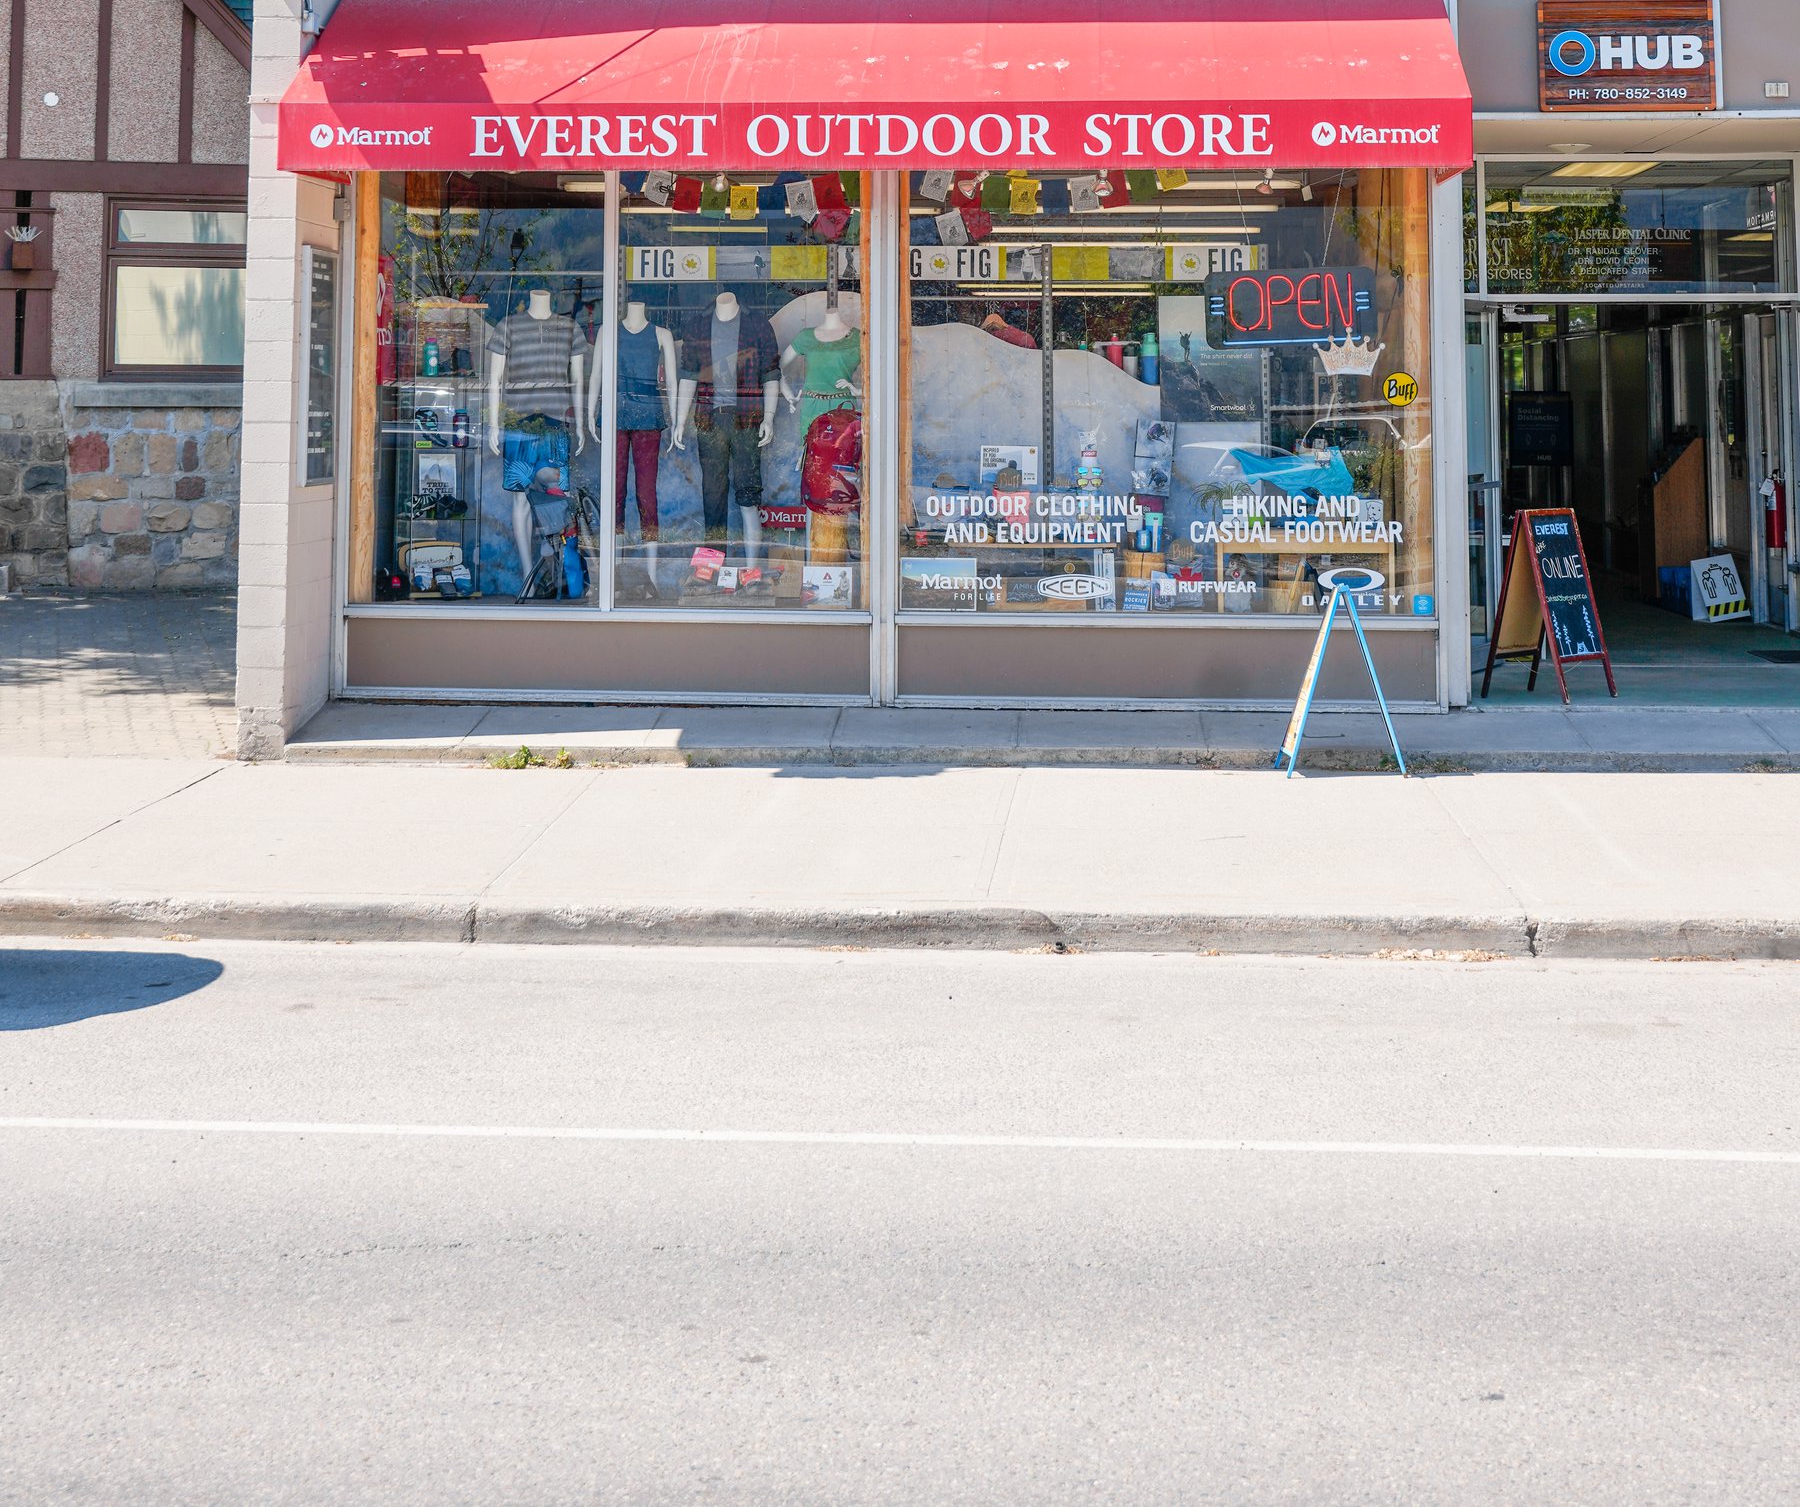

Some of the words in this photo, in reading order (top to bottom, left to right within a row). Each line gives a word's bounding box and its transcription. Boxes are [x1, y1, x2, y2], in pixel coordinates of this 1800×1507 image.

[1599, 35, 1705, 70] HUB
[1568, 89, 1590, 100] PH:
[1593, 87, 1688, 99] 780-852-3149
[336, 125, 433, 146] Marmot
[469, 113, 718, 157] EVEREST
[746, 113, 1057, 157] OUTDOOR
[1083, 113, 1274, 157] STORE
[1339, 123, 1441, 145] Marmot
[1208, 247, 1243, 274] FIG
[1567, 247, 1583, 255] DR.
[1585, 247, 1621, 255] RANDAL
[1623, 247, 1659, 255] GLOVER
[1577, 257, 1593, 265] DR.
[1595, 257, 1621, 265] DAVID
[1623, 257, 1650, 265] LEONI
[640, 248, 675, 278] FIG
[956, 248, 991, 278] FIG
[1569, 267, 1576, 275] &
[1580, 267, 1629, 275] DEDICATED
[1631, 267, 1658, 275] STAFF
[1487, 268, 1533, 280] STORES
[1228, 272, 1353, 332] OPEN
[926, 495, 1028, 517] OUTDOOR
[1035, 495, 1144, 517] CLOTHING
[1232, 495, 1307, 518] HIKING
[1315, 495, 1361, 518] AND
[770, 511, 807, 523] Marm
[943, 522, 988, 544] AND
[996, 522, 1125, 545] EQUIPMENT
[1189, 520, 1277, 544] CASUAL
[1284, 520, 1404, 544] FOOTWEAR
[1535, 522, 1569, 536] EVEREST
[1541, 554, 1585, 579] ONLINE
[921, 573, 1003, 590] Marmot
[1042, 578, 1106, 595] KEEN
[1178, 580, 1257, 594] RUFFWEAR
[953, 592, 973, 601] FOR
[979, 592, 1002, 601] LIFE
